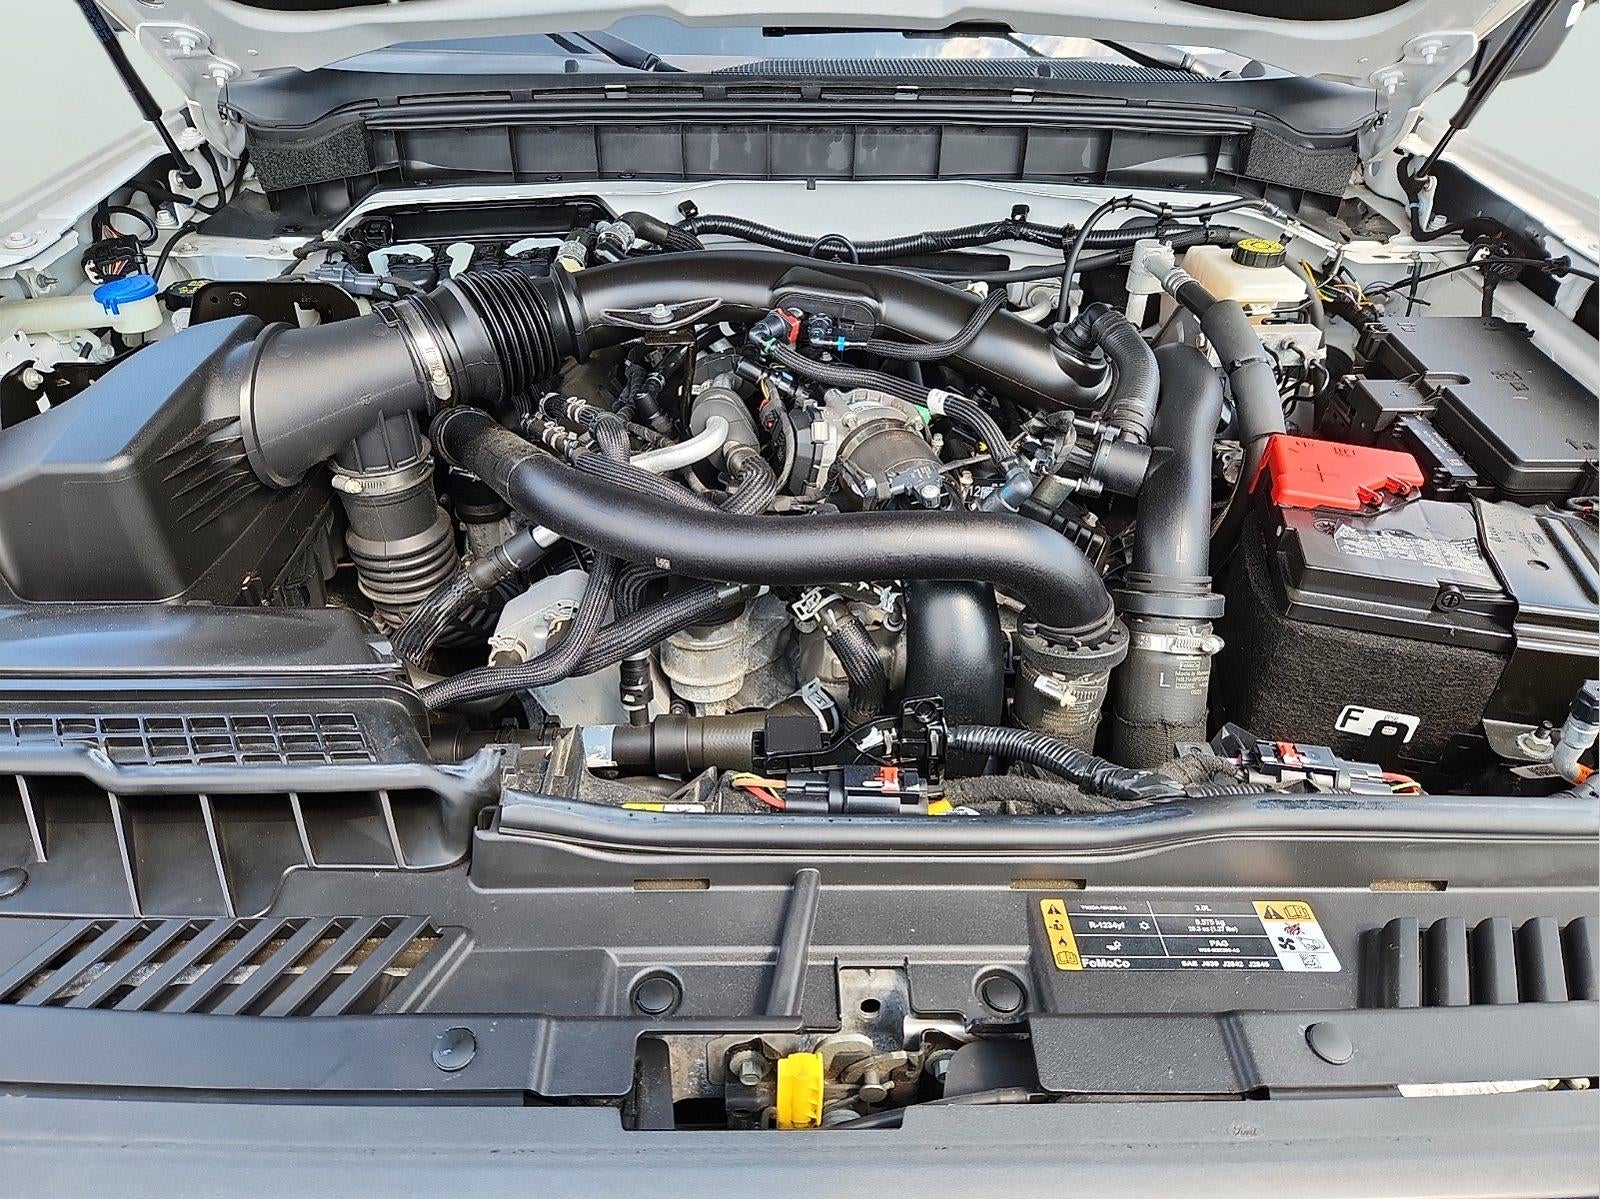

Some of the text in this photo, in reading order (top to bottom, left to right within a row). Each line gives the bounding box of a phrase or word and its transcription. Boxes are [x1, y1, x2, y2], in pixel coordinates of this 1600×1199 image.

[1159, 672, 1171, 687] L
[1340, 707, 1365, 728] F
[1088, 920, 1126, 930] R-1234yf
[1082, 957, 1132, 968] FoMoCo
